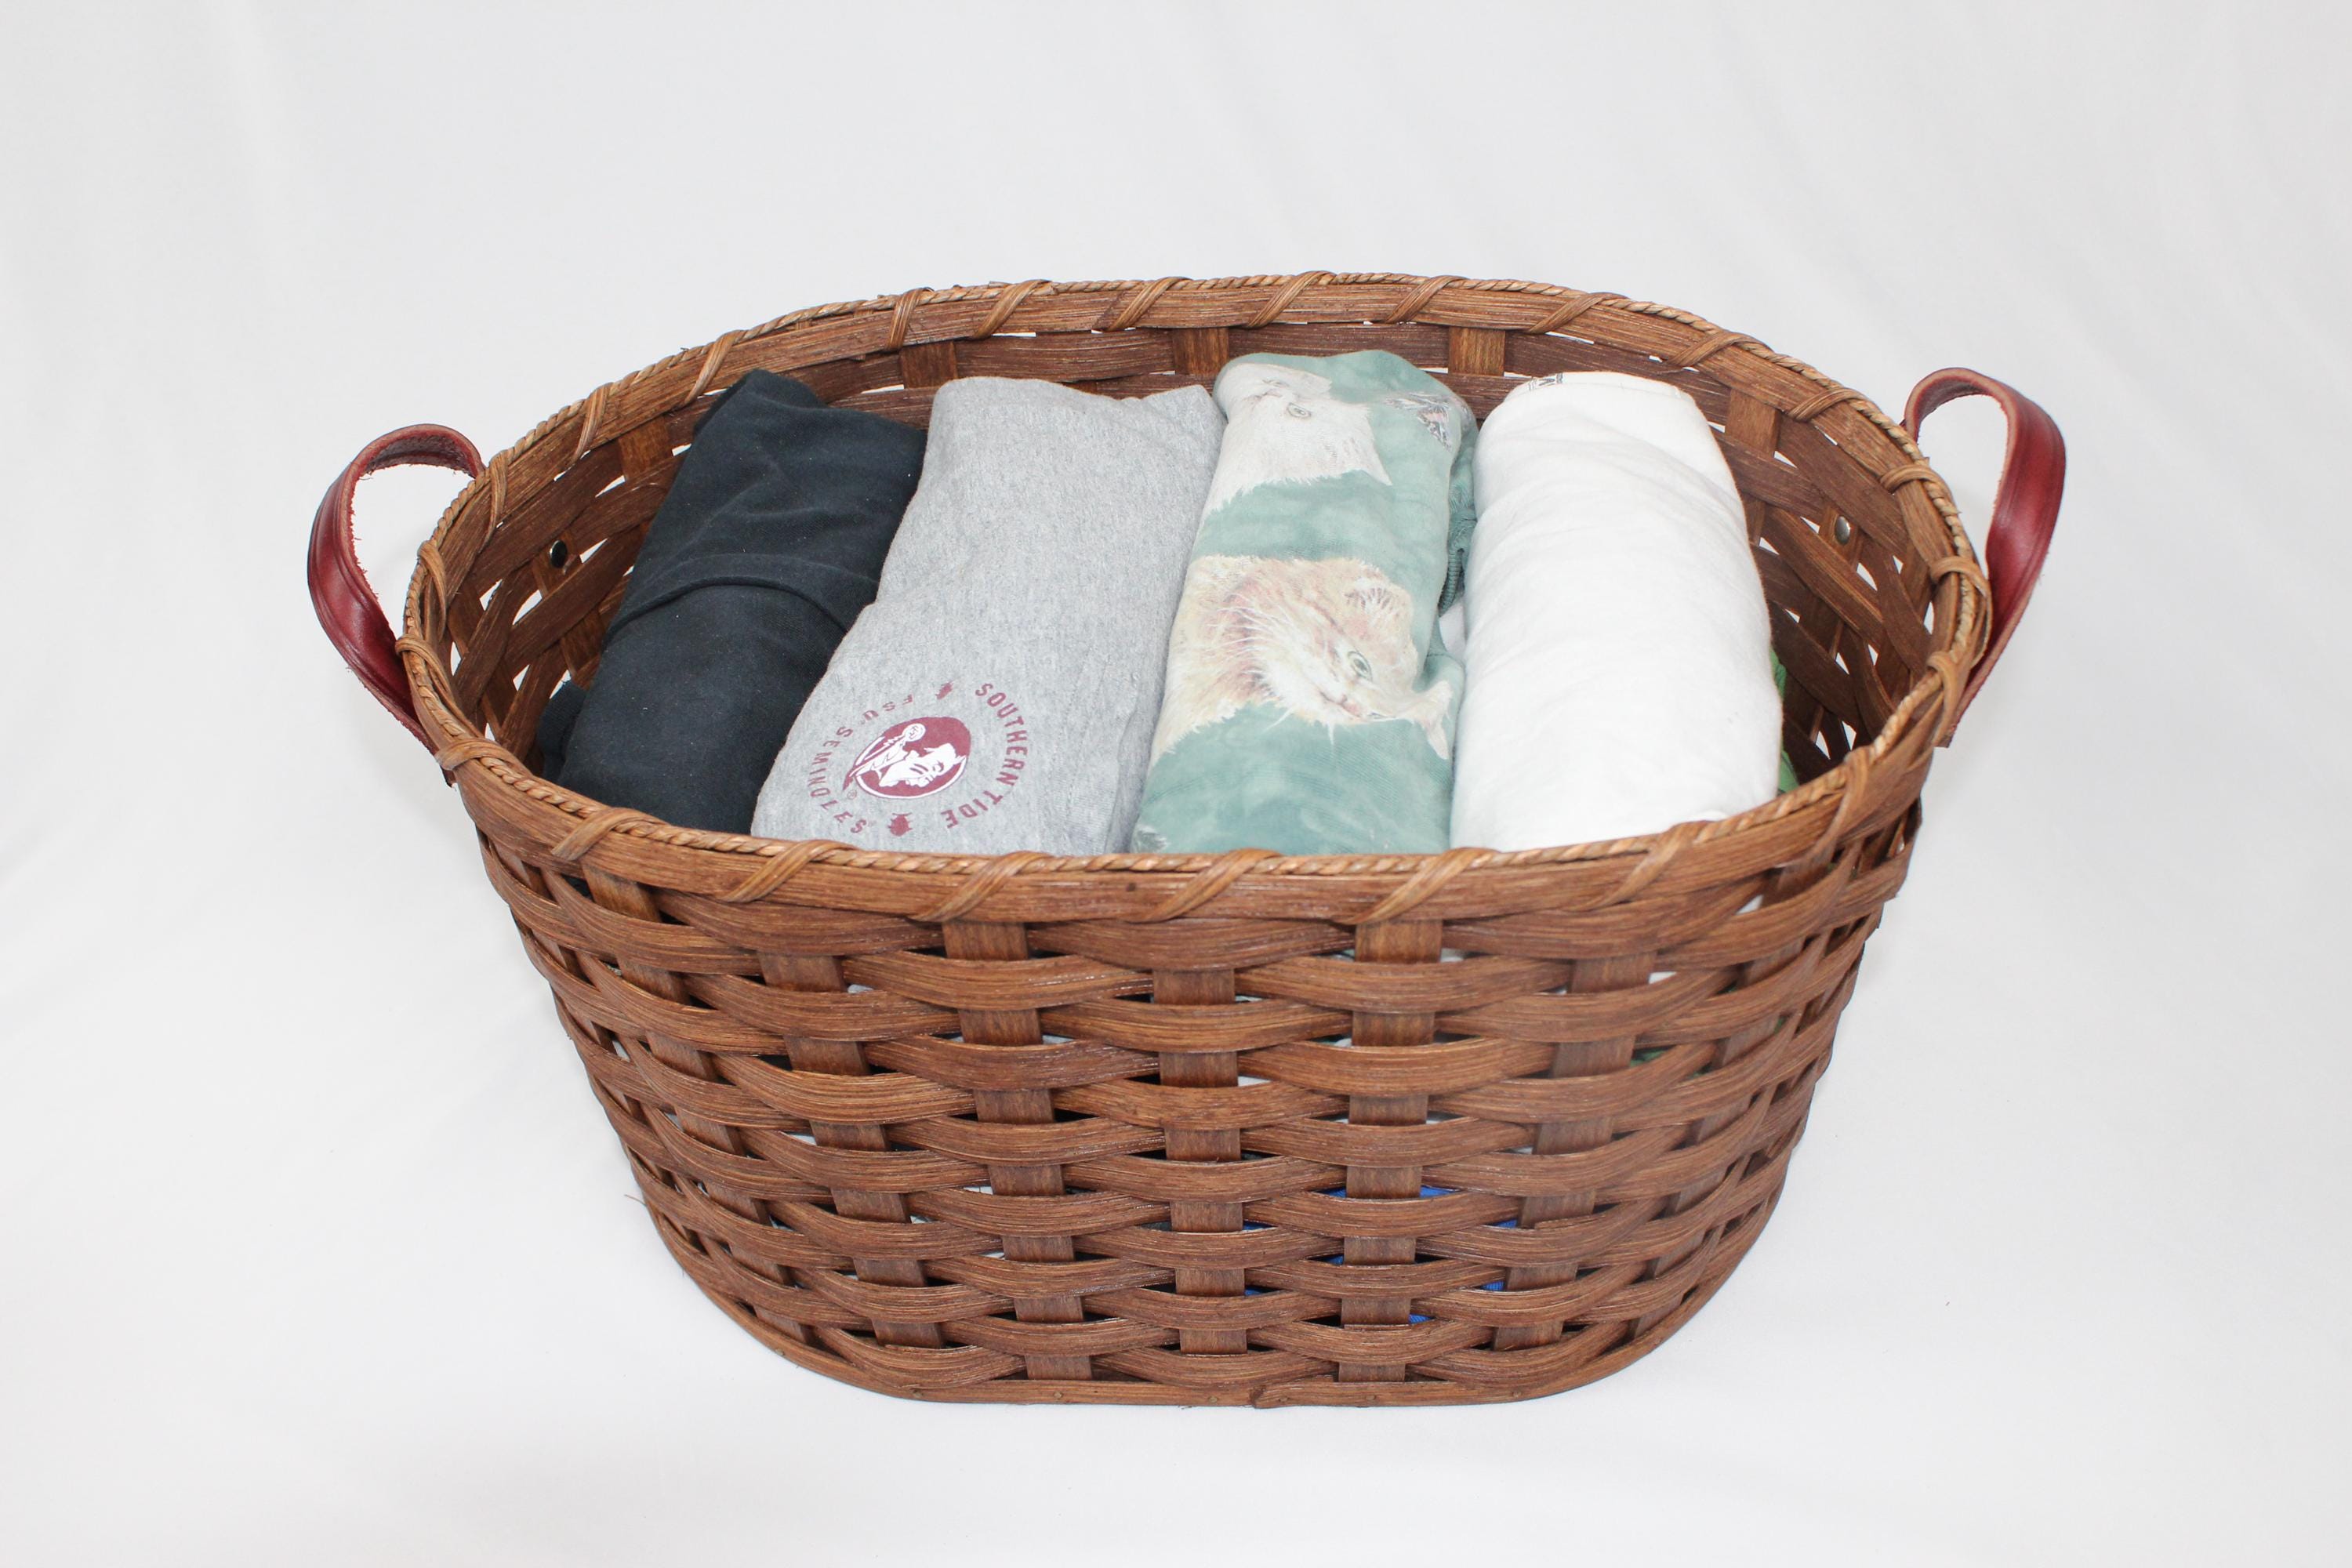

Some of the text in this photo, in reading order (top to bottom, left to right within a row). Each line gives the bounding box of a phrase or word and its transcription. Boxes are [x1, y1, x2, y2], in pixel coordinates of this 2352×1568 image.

[808, 694, 913, 833] FSU SEMINOLES
[941, 683, 1028, 829] SOUTHERN TIDE
